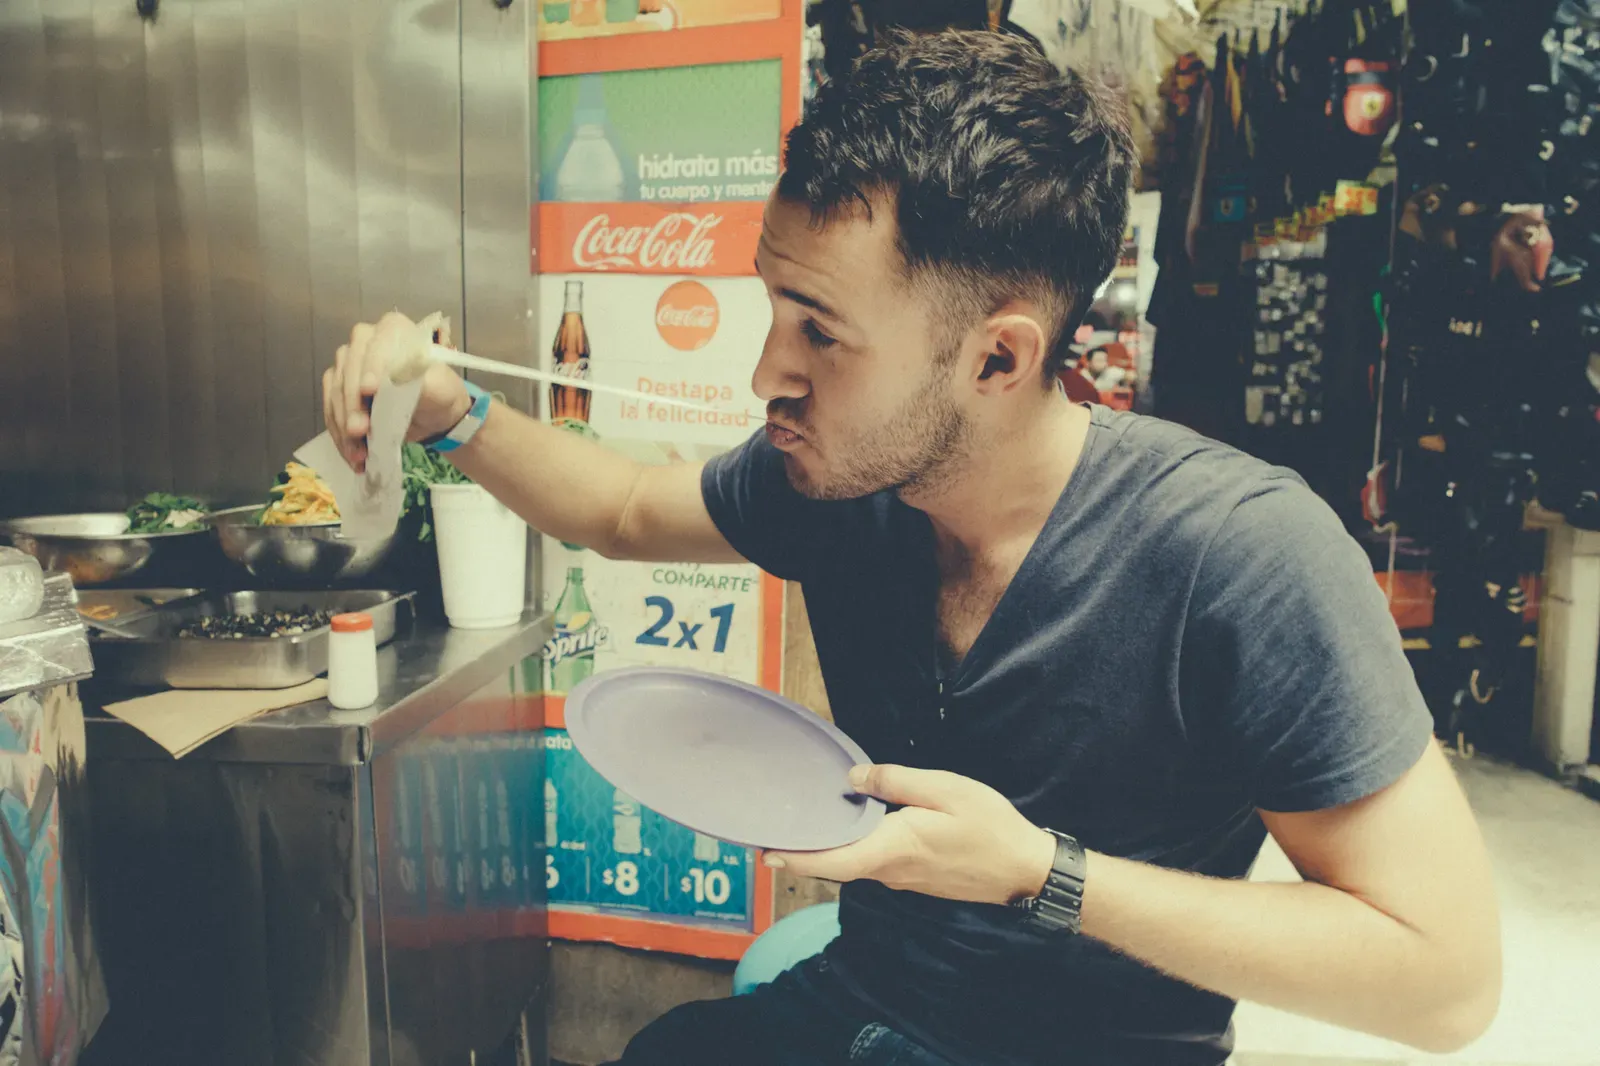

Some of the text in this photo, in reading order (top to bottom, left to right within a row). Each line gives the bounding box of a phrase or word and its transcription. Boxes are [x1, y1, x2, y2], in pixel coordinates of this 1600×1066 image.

[638, 149, 779, 180] hidrata más
[639, 184, 655, 200] tu
[658, 183, 710, 202] cuerpo
[712, 183, 723, 200] y
[636, 376, 734, 404] Destapa
[620, 401, 749, 427] la felicidad
[652, 568, 753, 593] COMPARTE
[635, 595, 735, 654] 2x1
[541, 620, 609, 664] Sprite
[602, 860, 640, 897] $8
[680, 867, 731, 906] $10
